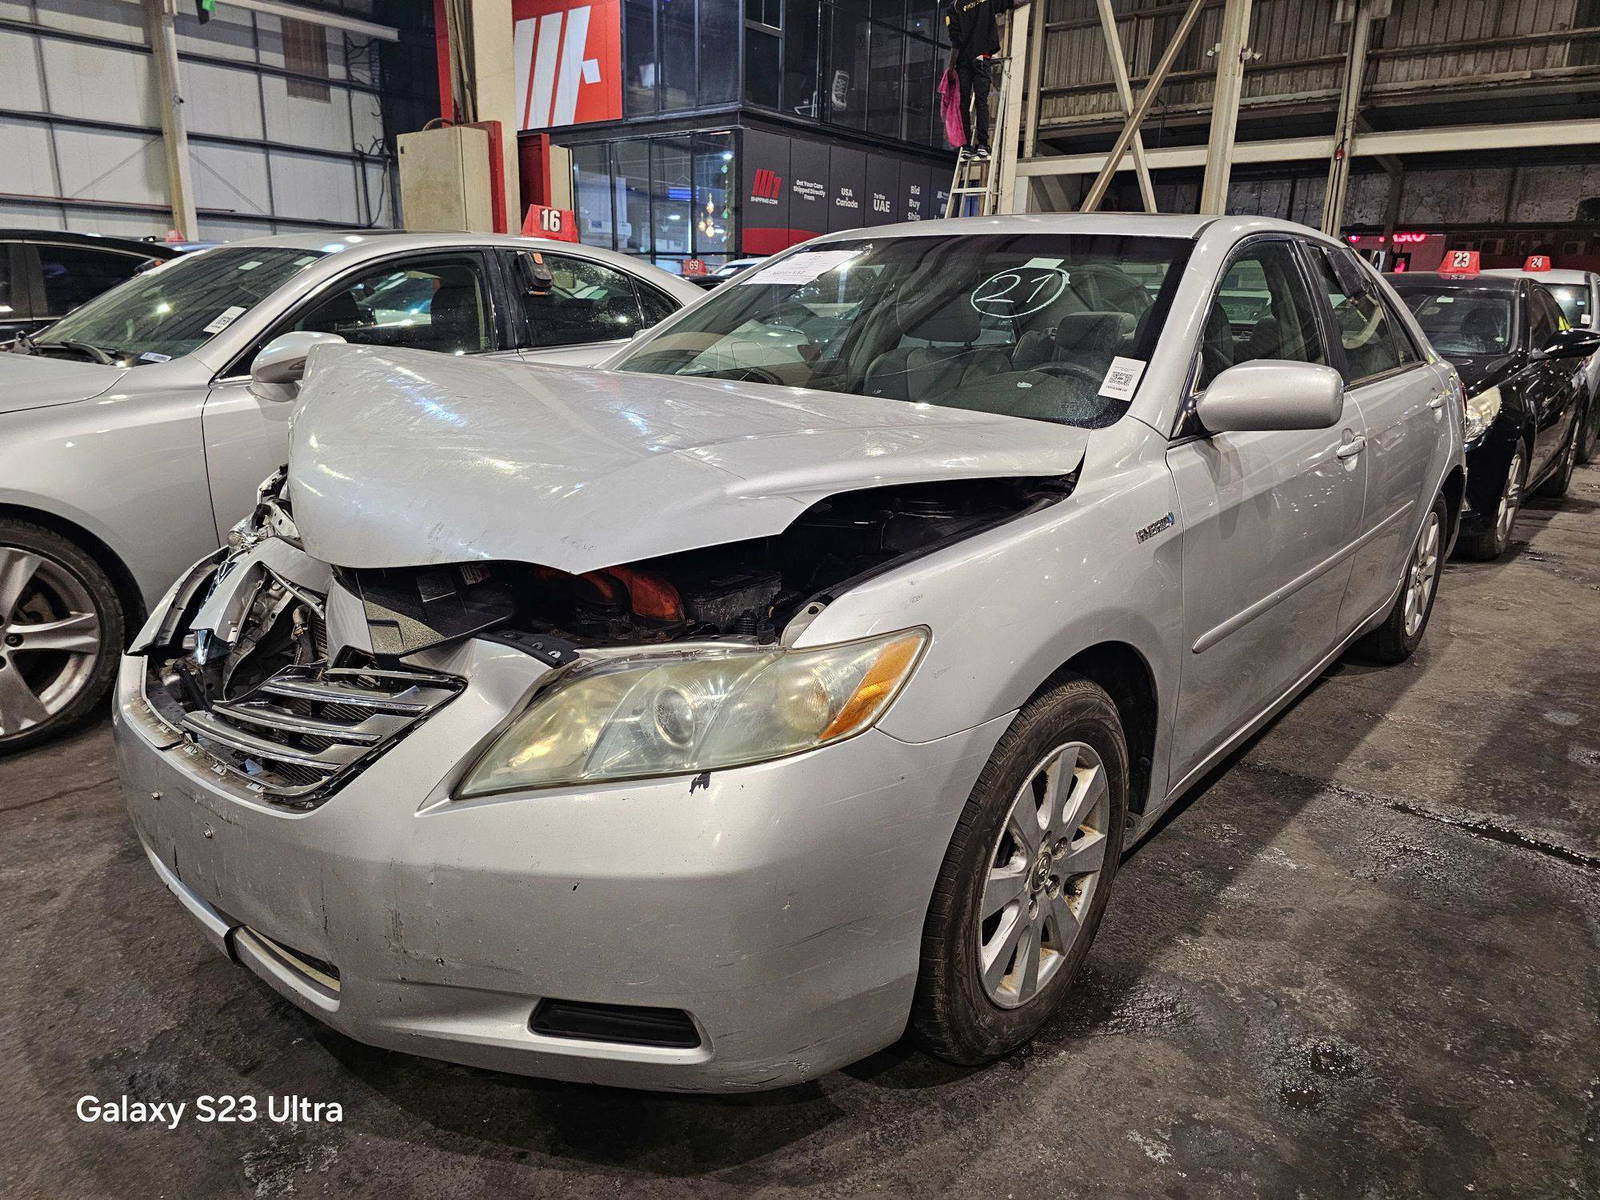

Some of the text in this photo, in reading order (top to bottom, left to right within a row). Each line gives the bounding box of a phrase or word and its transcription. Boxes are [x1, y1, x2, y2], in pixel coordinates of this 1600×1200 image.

[841, 188, 853, 197] USA
[910, 185, 920, 195] Bid
[835, 198, 858, 208] Canada
[873, 199, 891, 213] UAE
[908, 199, 920, 211] Buy
[541, 209, 561, 232] 16
[1453, 252, 1471, 268] 23
[1531, 256, 1543, 268] 24
[975, 273, 1055, 304] 21
